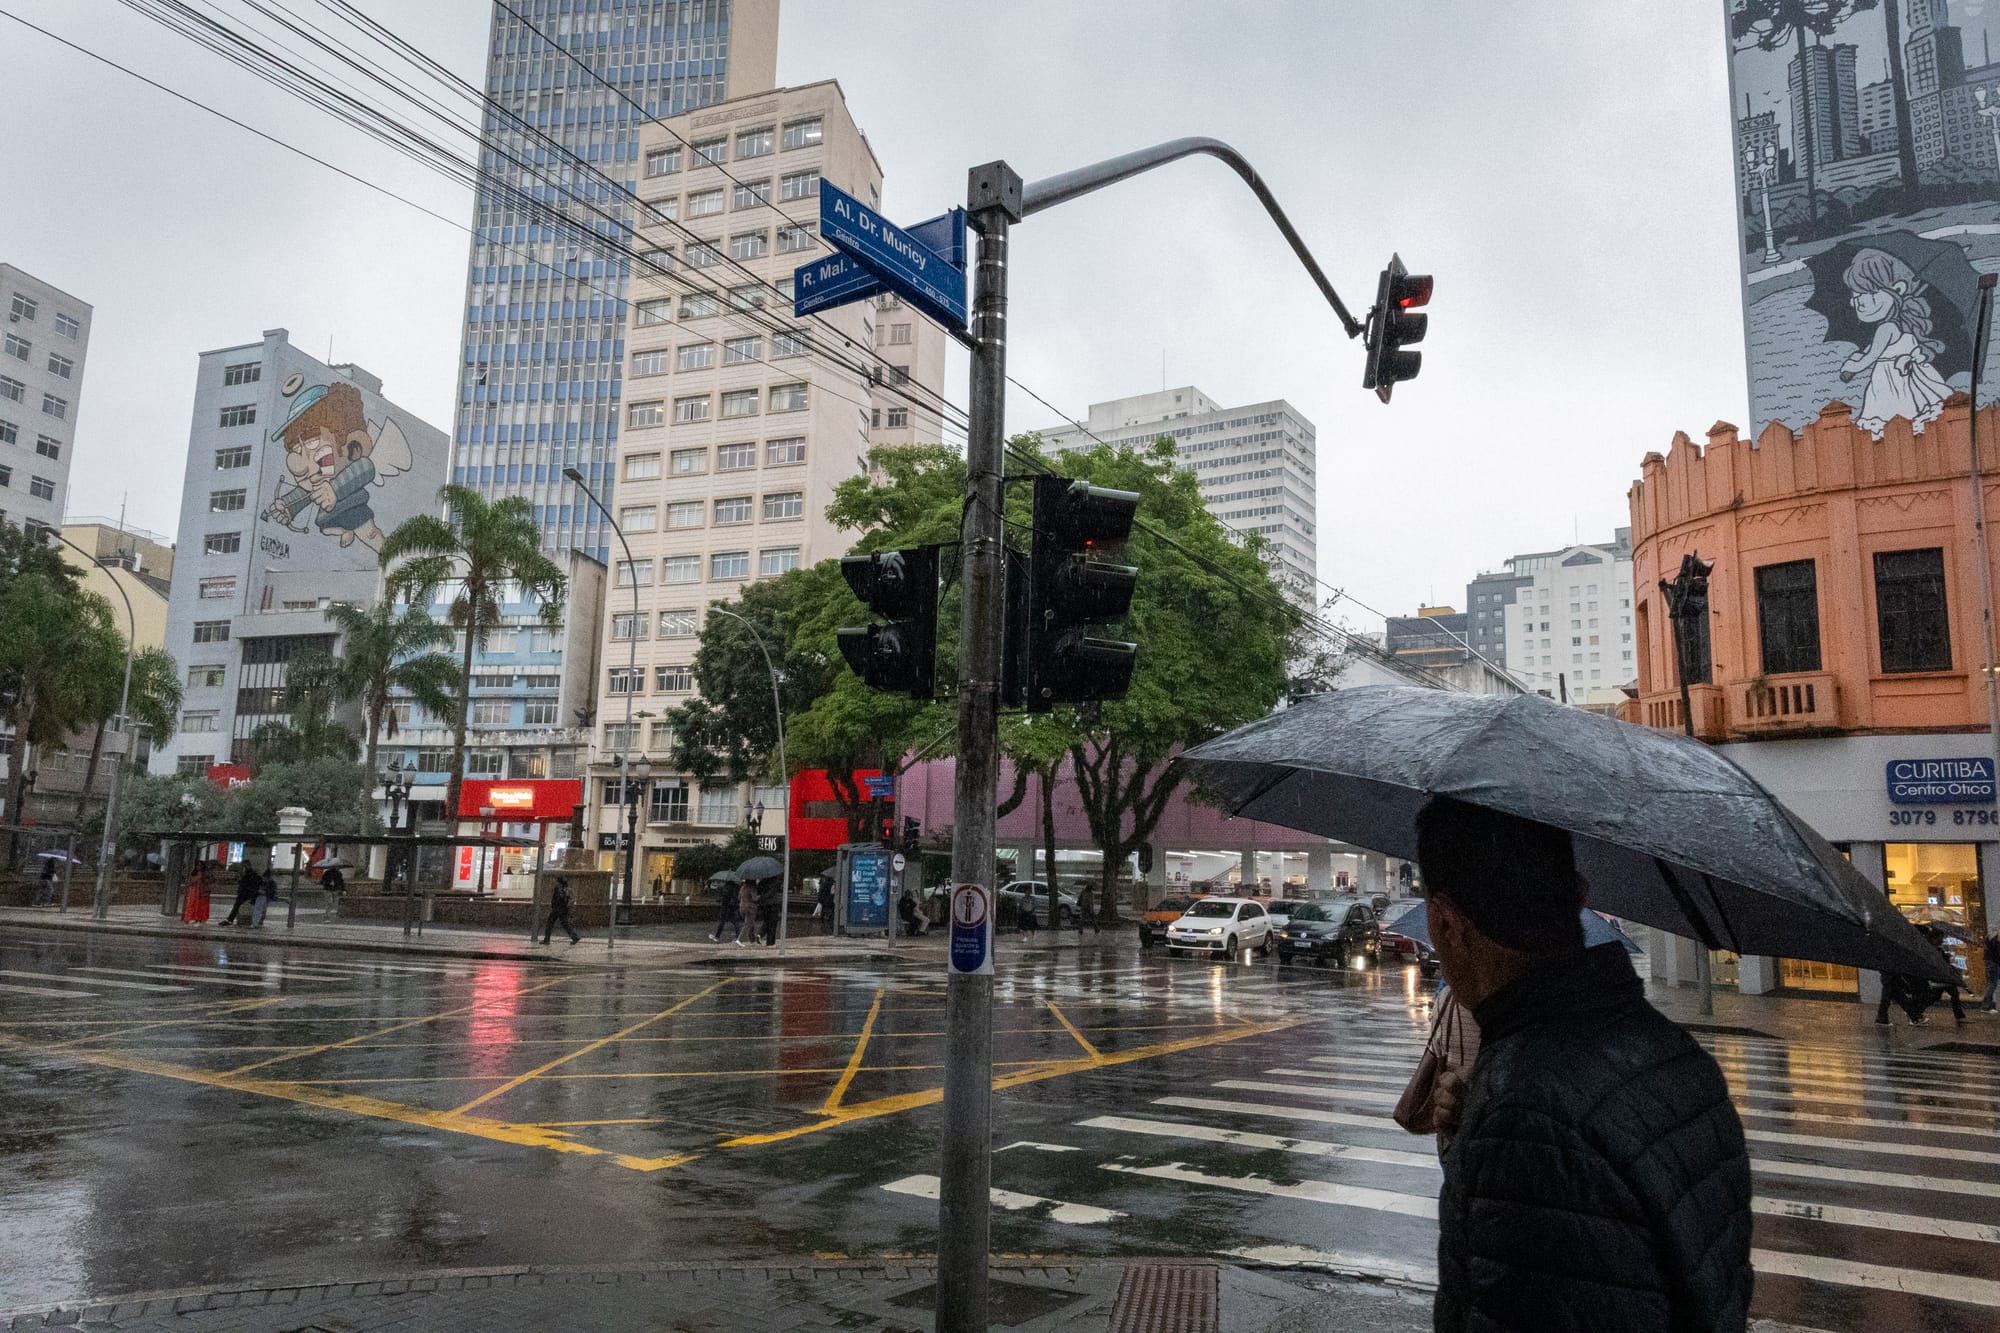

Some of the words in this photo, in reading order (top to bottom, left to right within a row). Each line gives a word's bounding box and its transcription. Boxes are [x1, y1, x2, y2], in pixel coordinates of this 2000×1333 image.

[834, 198, 855, 222] Al.
[860, 211, 879, 238] Dr.
[882, 227, 927, 270] Muricy
[835, 228, 860, 250] Centro
[802, 272, 816, 289] R.
[820, 259, 848, 281] Mal.
[803, 295, 826, 309] Centro
[1895, 761, 1988, 779] CURITIBA
[1895, 784, 1947, 796] Centro
[1889, 810, 1937, 825] 3079
